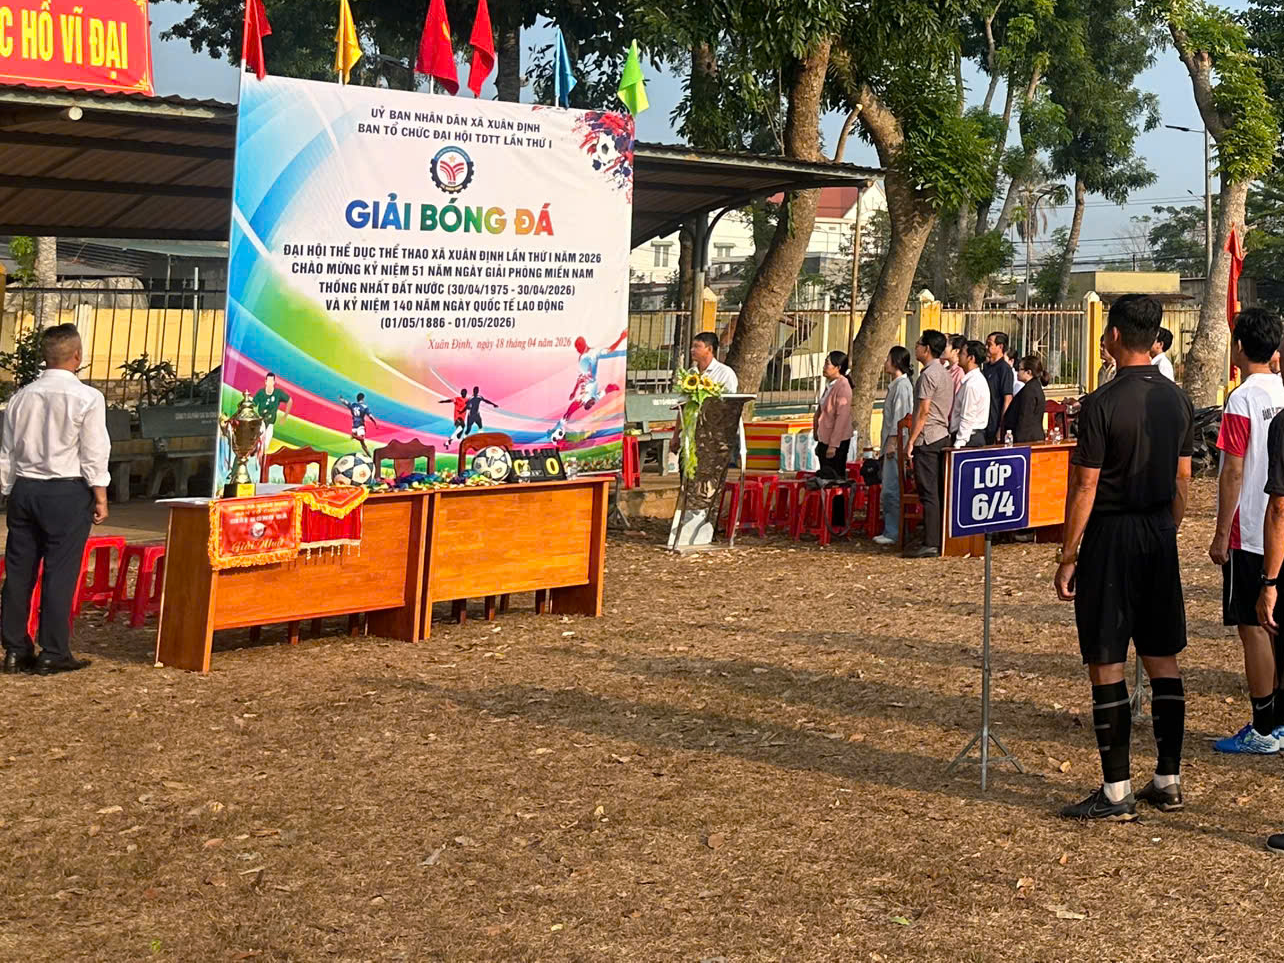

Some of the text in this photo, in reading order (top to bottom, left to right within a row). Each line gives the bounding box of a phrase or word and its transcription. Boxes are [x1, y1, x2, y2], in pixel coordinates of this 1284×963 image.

[60, 6, 83, 64] VĨ
[89, 19, 129, 79] ĐẠI
[389, 110, 411, 121] BAN
[414, 110, 443, 124] NHÂN
[446, 113, 467, 126] DÂN
[470, 115, 484, 127] XÃ
[487, 116, 514, 130] XUÂN
[516, 121, 540, 134] ĐỊNH
[358, 123, 380, 134] BAN
[383, 121, 399, 136] TỔ
[401, 125, 430, 139] CHỨC
[433, 129, 451, 142] ĐẠI
[454, 129, 472, 144] HỘI
[475, 133, 500, 145] TDTT
[526, 136, 546, 149] THỨ
[548, 140, 552, 149] I
[345, 192, 554, 236] GIẢI BÓNG ĐÁ
[283, 244, 304, 258] ĐẠI
[306, 243, 327, 259] HỘI
[330, 242, 352, 257] THỂ
[353, 246, 376, 260] DỤC
[379, 244, 400, 259] THỂ
[401, 248, 429, 259] THAO
[431, 247, 446, 260] XÃ
[448, 249, 477, 261] XUÂN
[479, 250, 504, 263] ĐỊNH
[528, 250, 548, 262] THỨ
[554, 251, 576, 263] NĂM
[578, 253, 601, 263] 2026
[291, 260, 323, 274] CHÀO
[326, 263, 361, 275] MỪNG
[363, 261, 378, 275] KỶ
[381, 263, 409, 278] NIỆM
[412, 266, 424, 276] 51
[427, 264, 452, 277] NĂM
[455, 265, 483, 278] NGÀY
[485, 264, 506, 278] GIẢI
[572, 268, 594, 278] NAM
[319, 278, 357, 294] THỐNG
[360, 279, 388, 294] NHẤT
[391, 279, 412, 294] ĐẤT
[415, 281, 445, 294] NƯỚC
[447, 283, 509, 296] (30/04/1975
[517, 284, 576, 296] 30/04/2026)
[325, 296, 564, 314] VÀ KỶ NIỆM 140 NĂM NGÀY QUỐC TẾ LAO ĐỘNG
[380, 317, 445, 329] (01/05/1886
[454, 317, 515, 329] 01/05/2026)
[427, 337, 572, 351] Xuân Định, ngày 18 tháng 04 năm 2026
[545, 457, 560, 475] 0
[973, 461, 1012, 489] LỚP
[971, 490, 1015, 521] 6/4
